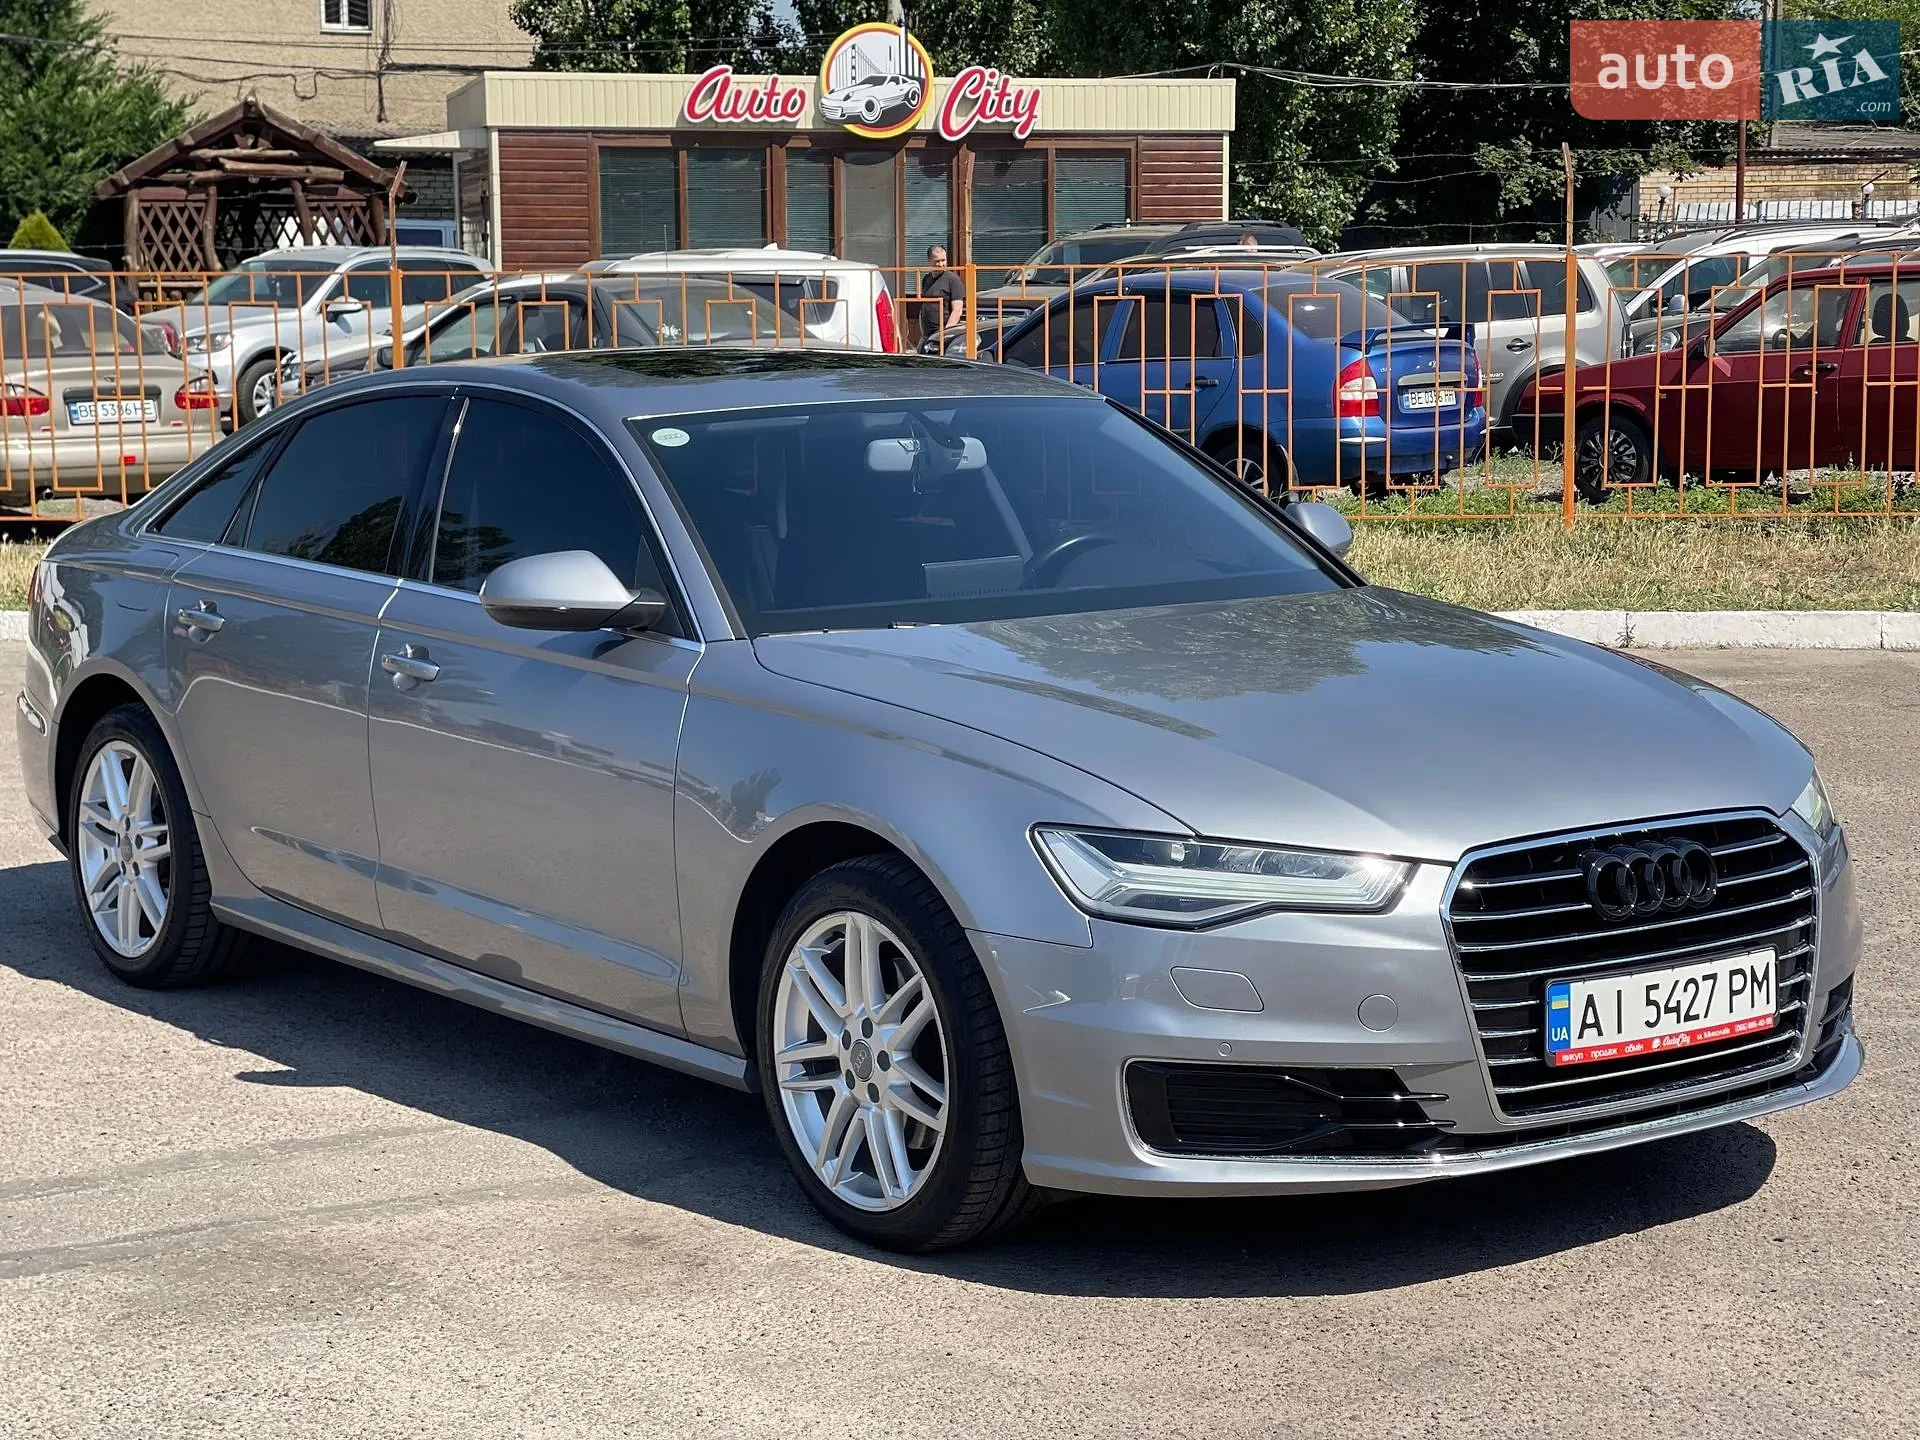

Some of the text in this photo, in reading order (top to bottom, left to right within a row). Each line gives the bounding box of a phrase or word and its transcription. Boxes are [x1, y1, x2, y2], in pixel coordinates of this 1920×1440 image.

[685, 66, 1042, 141] Auto City
[1577, 962, 1770, 1040] AI 5427 PM
[1551, 1026, 1569, 1042] UA
[1591, 1048, 1618, 1060] продаж
